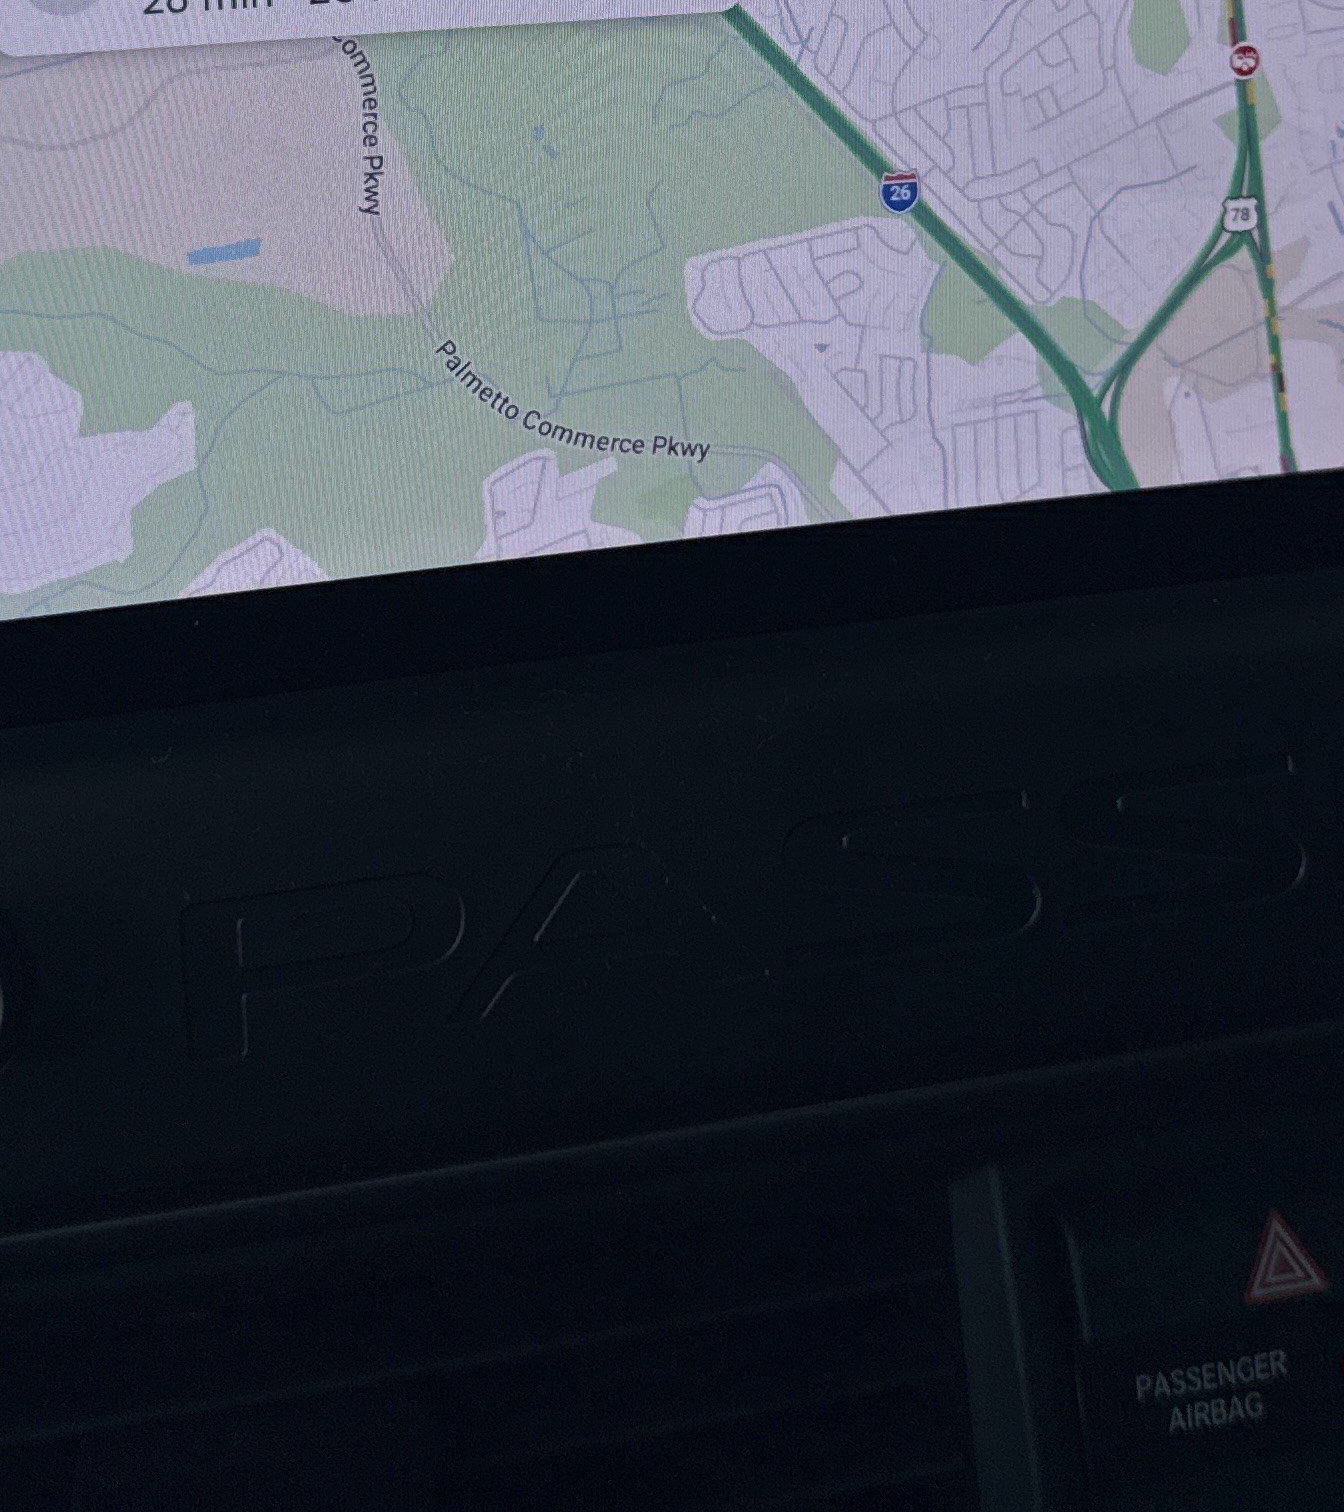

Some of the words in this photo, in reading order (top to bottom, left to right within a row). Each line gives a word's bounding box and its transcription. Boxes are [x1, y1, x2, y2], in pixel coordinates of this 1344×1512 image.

[332, 36, 378, 148] ommerce
[359, 155, 384, 215] Pkwy
[889, 184, 911, 203] 26
[1231, 207, 1250, 221] 78
[435, 340, 518, 422] Palmetto
[522, 410, 645, 456] Commerce
[652, 435, 711, 462] Pkwy
[1136, 1350, 1288, 1401] PASSENGER
[1169, 1396, 1264, 1434] AIRBAG
